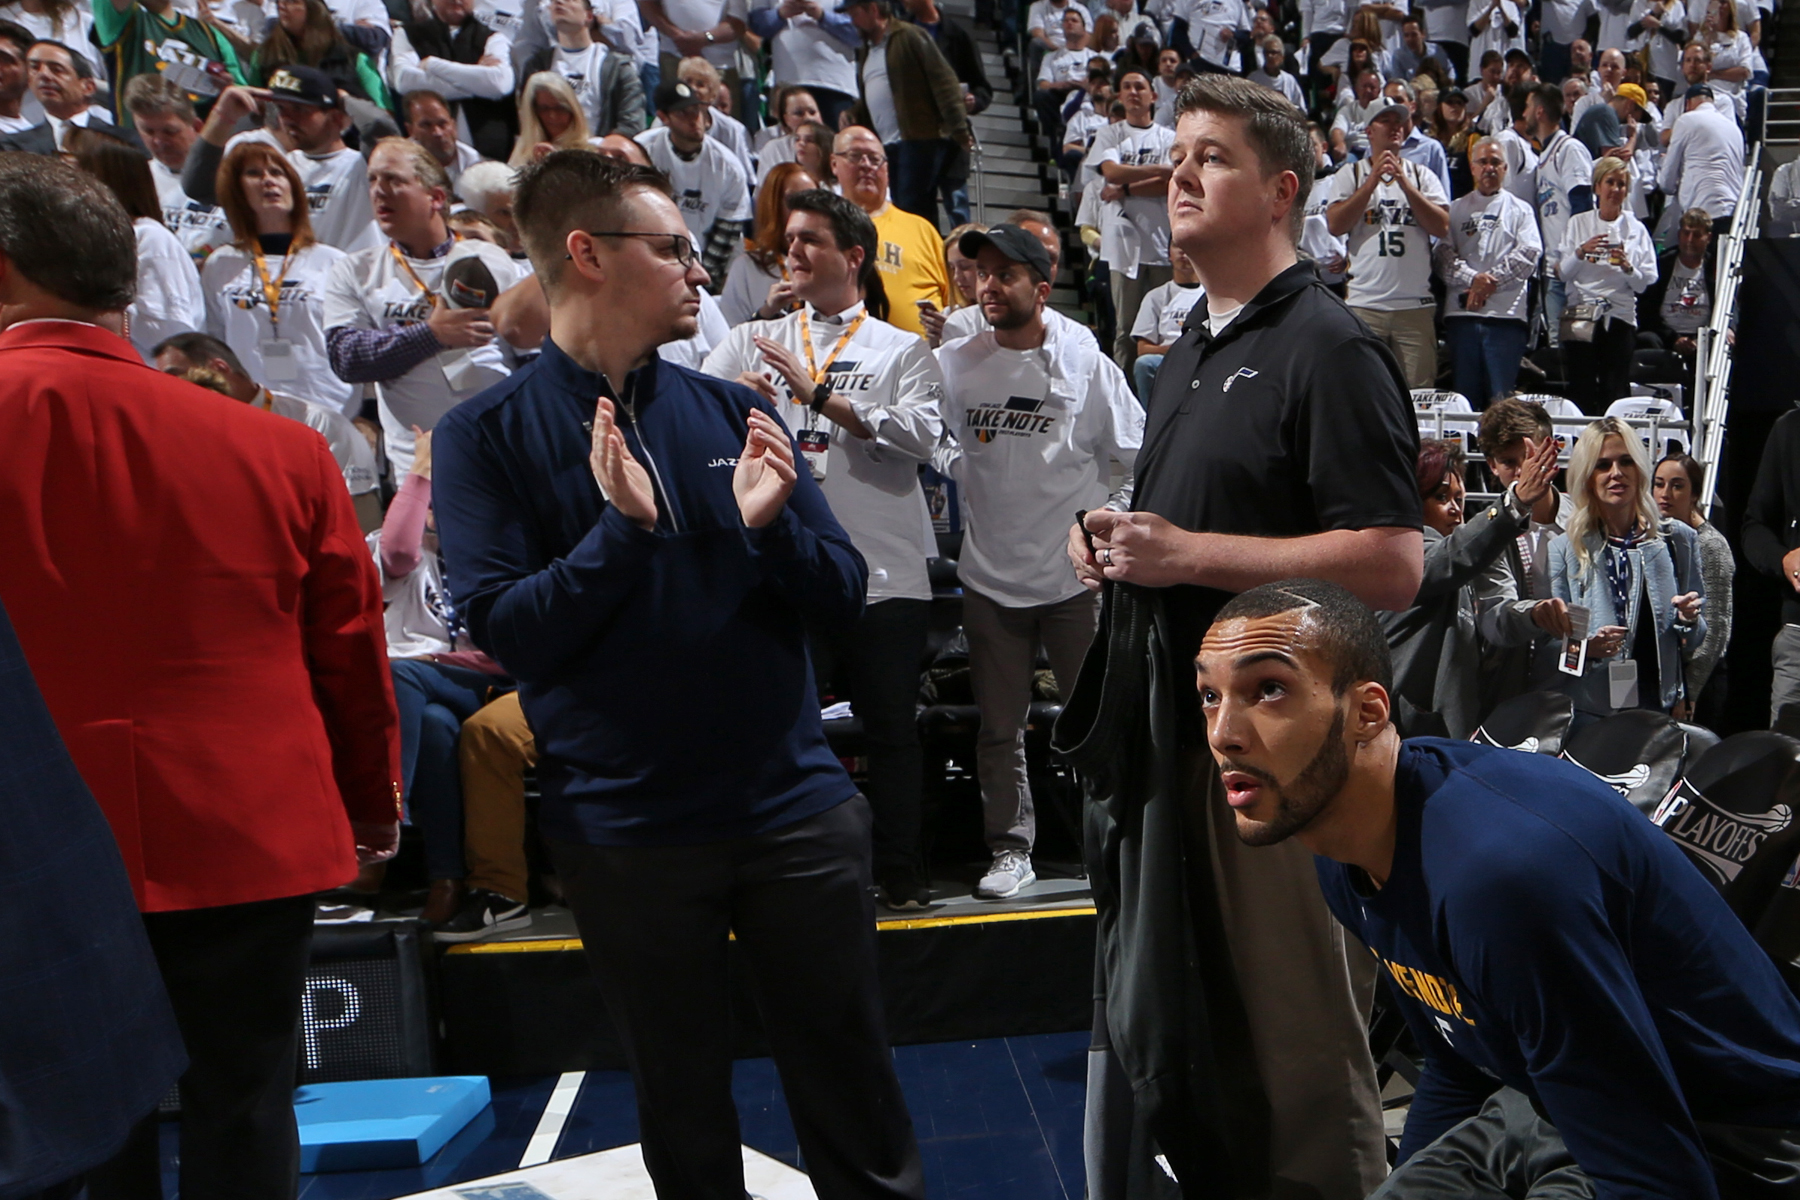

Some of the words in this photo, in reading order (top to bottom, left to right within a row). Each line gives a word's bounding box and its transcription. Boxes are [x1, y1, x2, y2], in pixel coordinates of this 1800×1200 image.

[1378, 231, 1405, 258] 15
[383, 301, 428, 320] TAKE
[966, 408, 1005, 428] TAKE
[1002, 411, 1055, 434] NOTE
[708, 458, 741, 467] JAZ
[1657, 795, 1768, 862] PLAYOFFS
